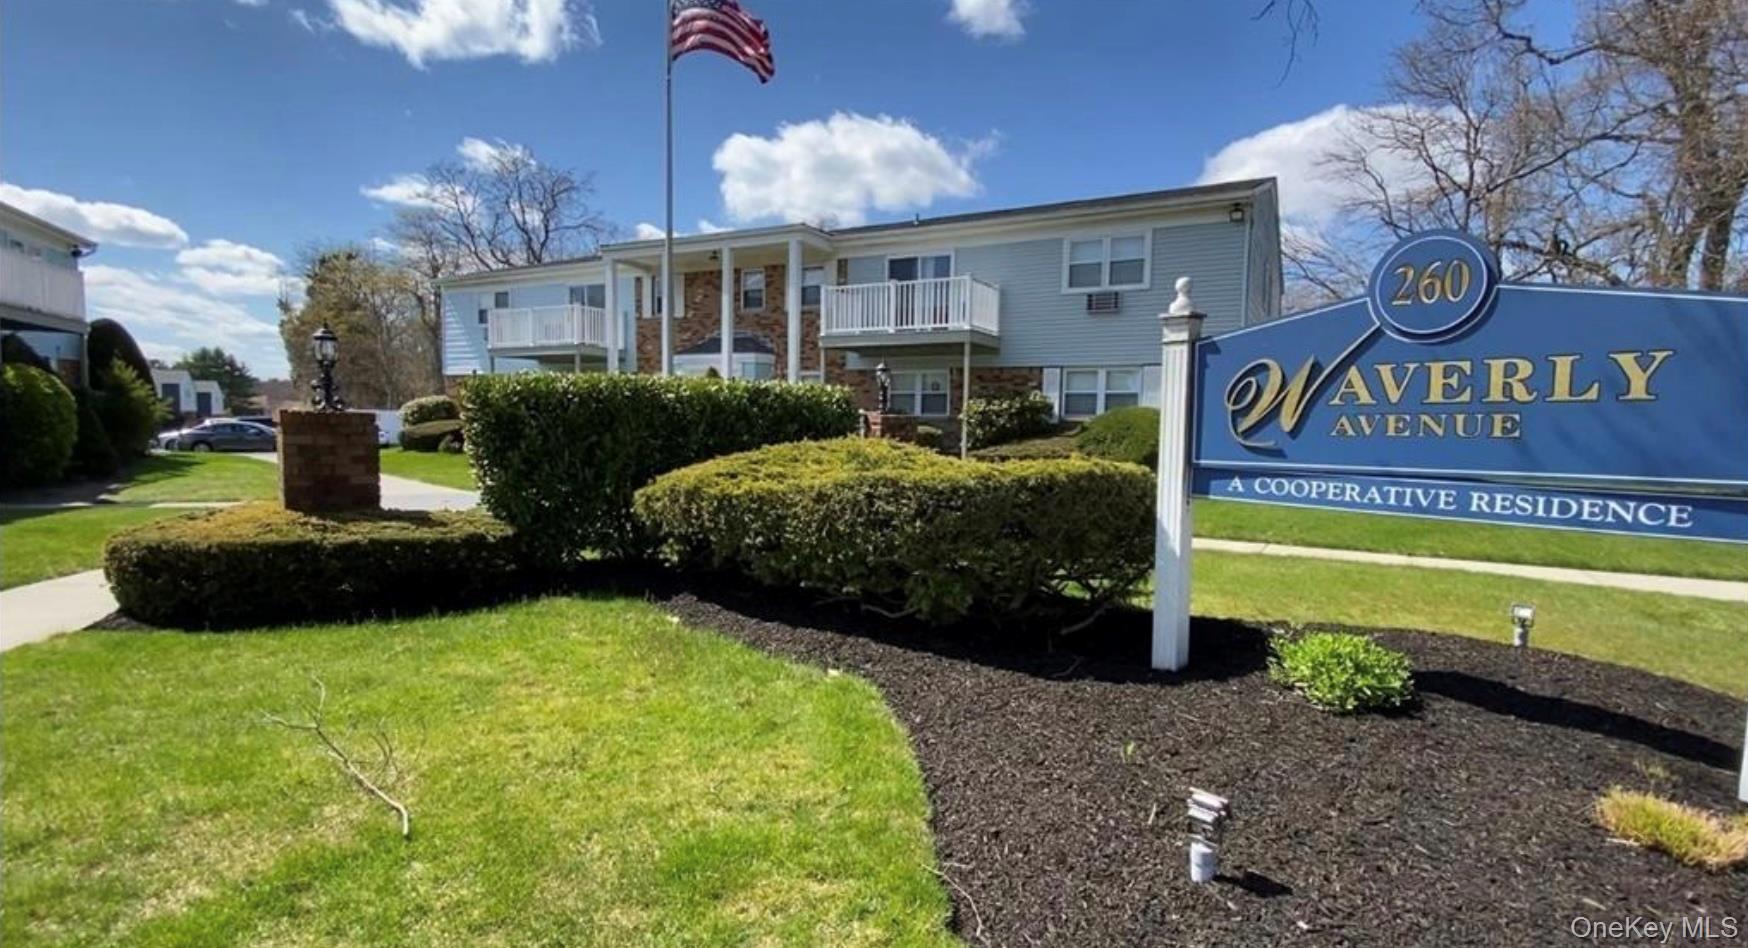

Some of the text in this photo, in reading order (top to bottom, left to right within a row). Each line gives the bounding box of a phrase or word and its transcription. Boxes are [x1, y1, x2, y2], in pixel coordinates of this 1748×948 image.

[1390, 258, 1471, 307] 260
[1225, 323, 1675, 448] WAVERLY
[1331, 412, 1522, 439] AVENUE
[1227, 477, 1694, 528] A COOPERATIVE RESIDENCE
